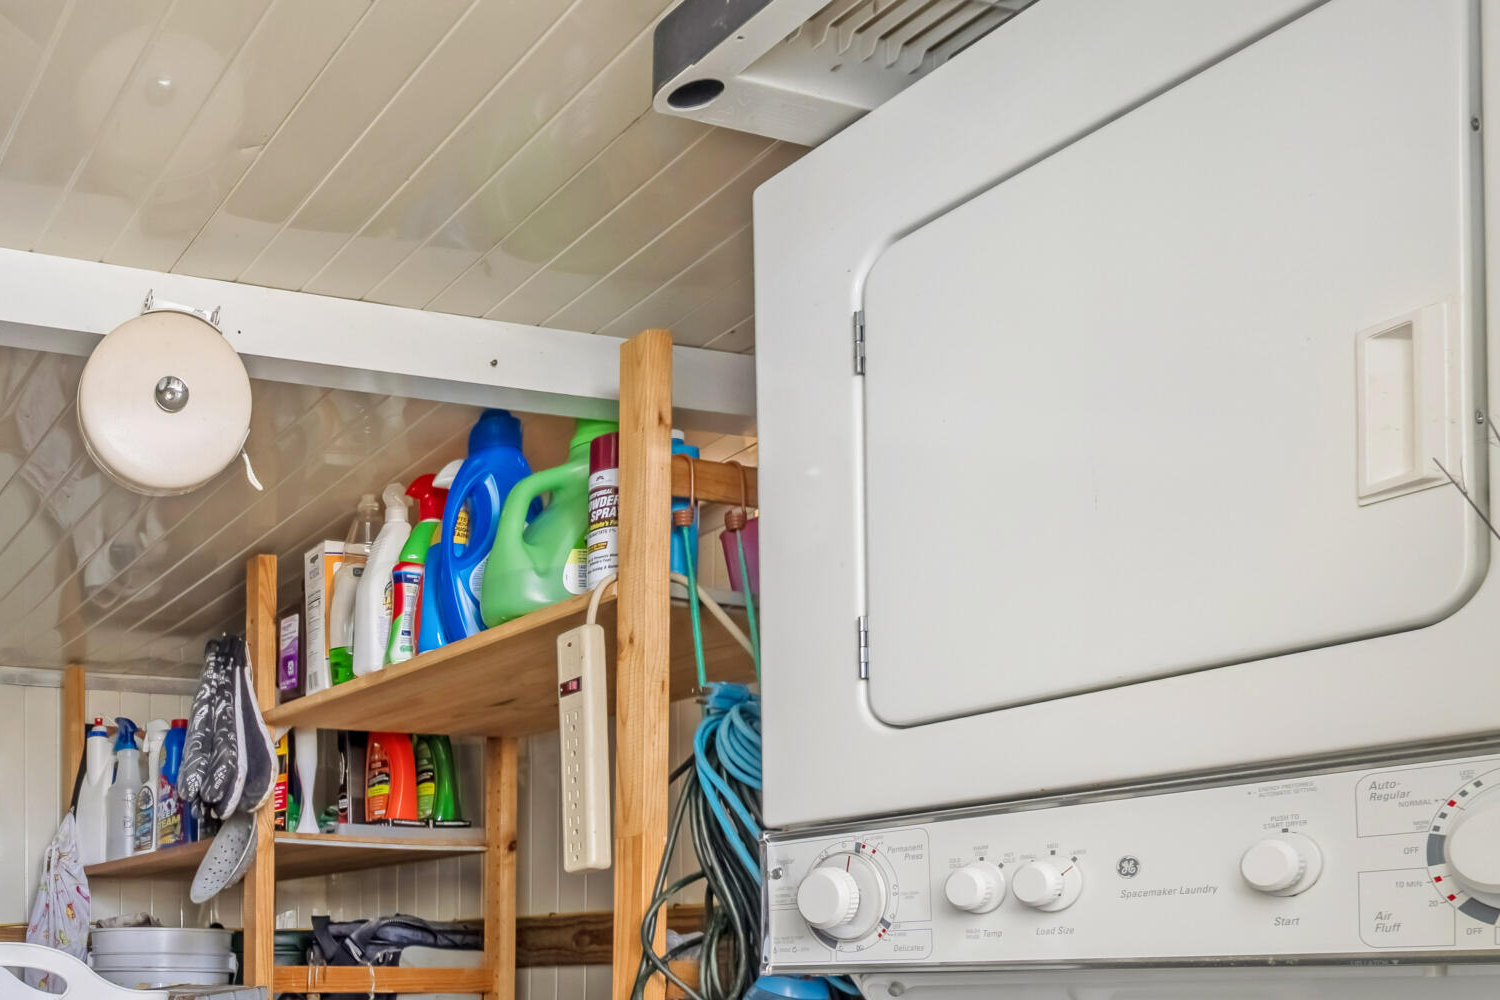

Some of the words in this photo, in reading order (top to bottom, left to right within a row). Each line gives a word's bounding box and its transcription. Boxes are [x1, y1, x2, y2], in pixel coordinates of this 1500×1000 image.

[591, 506, 617, 522] SPRA
[1369, 780, 1401, 791] Auto-
[1369, 790, 1412, 802] Regular
[1398, 799, 1433, 808] NORMAL
[887, 843, 923, 854] Permanent
[1403, 847, 1419, 855] OFF
[905, 852, 924, 861] Press
[1406, 880, 1423, 888] MIN
[1120, 887, 1177, 899] Spacemaker
[1179, 884, 1218, 896] Laundry
[1375, 911, 1393, 921] Air
[1274, 916, 1300, 927] Start
[1036, 927, 1056, 936] Load
[1058, 926, 1075, 935] Size
[1375, 922, 1402, 933] Fluff
[1466, 927, 1483, 935] OFF
[983, 929, 1003, 939] Temp
[893, 944, 925, 952] Delicates
